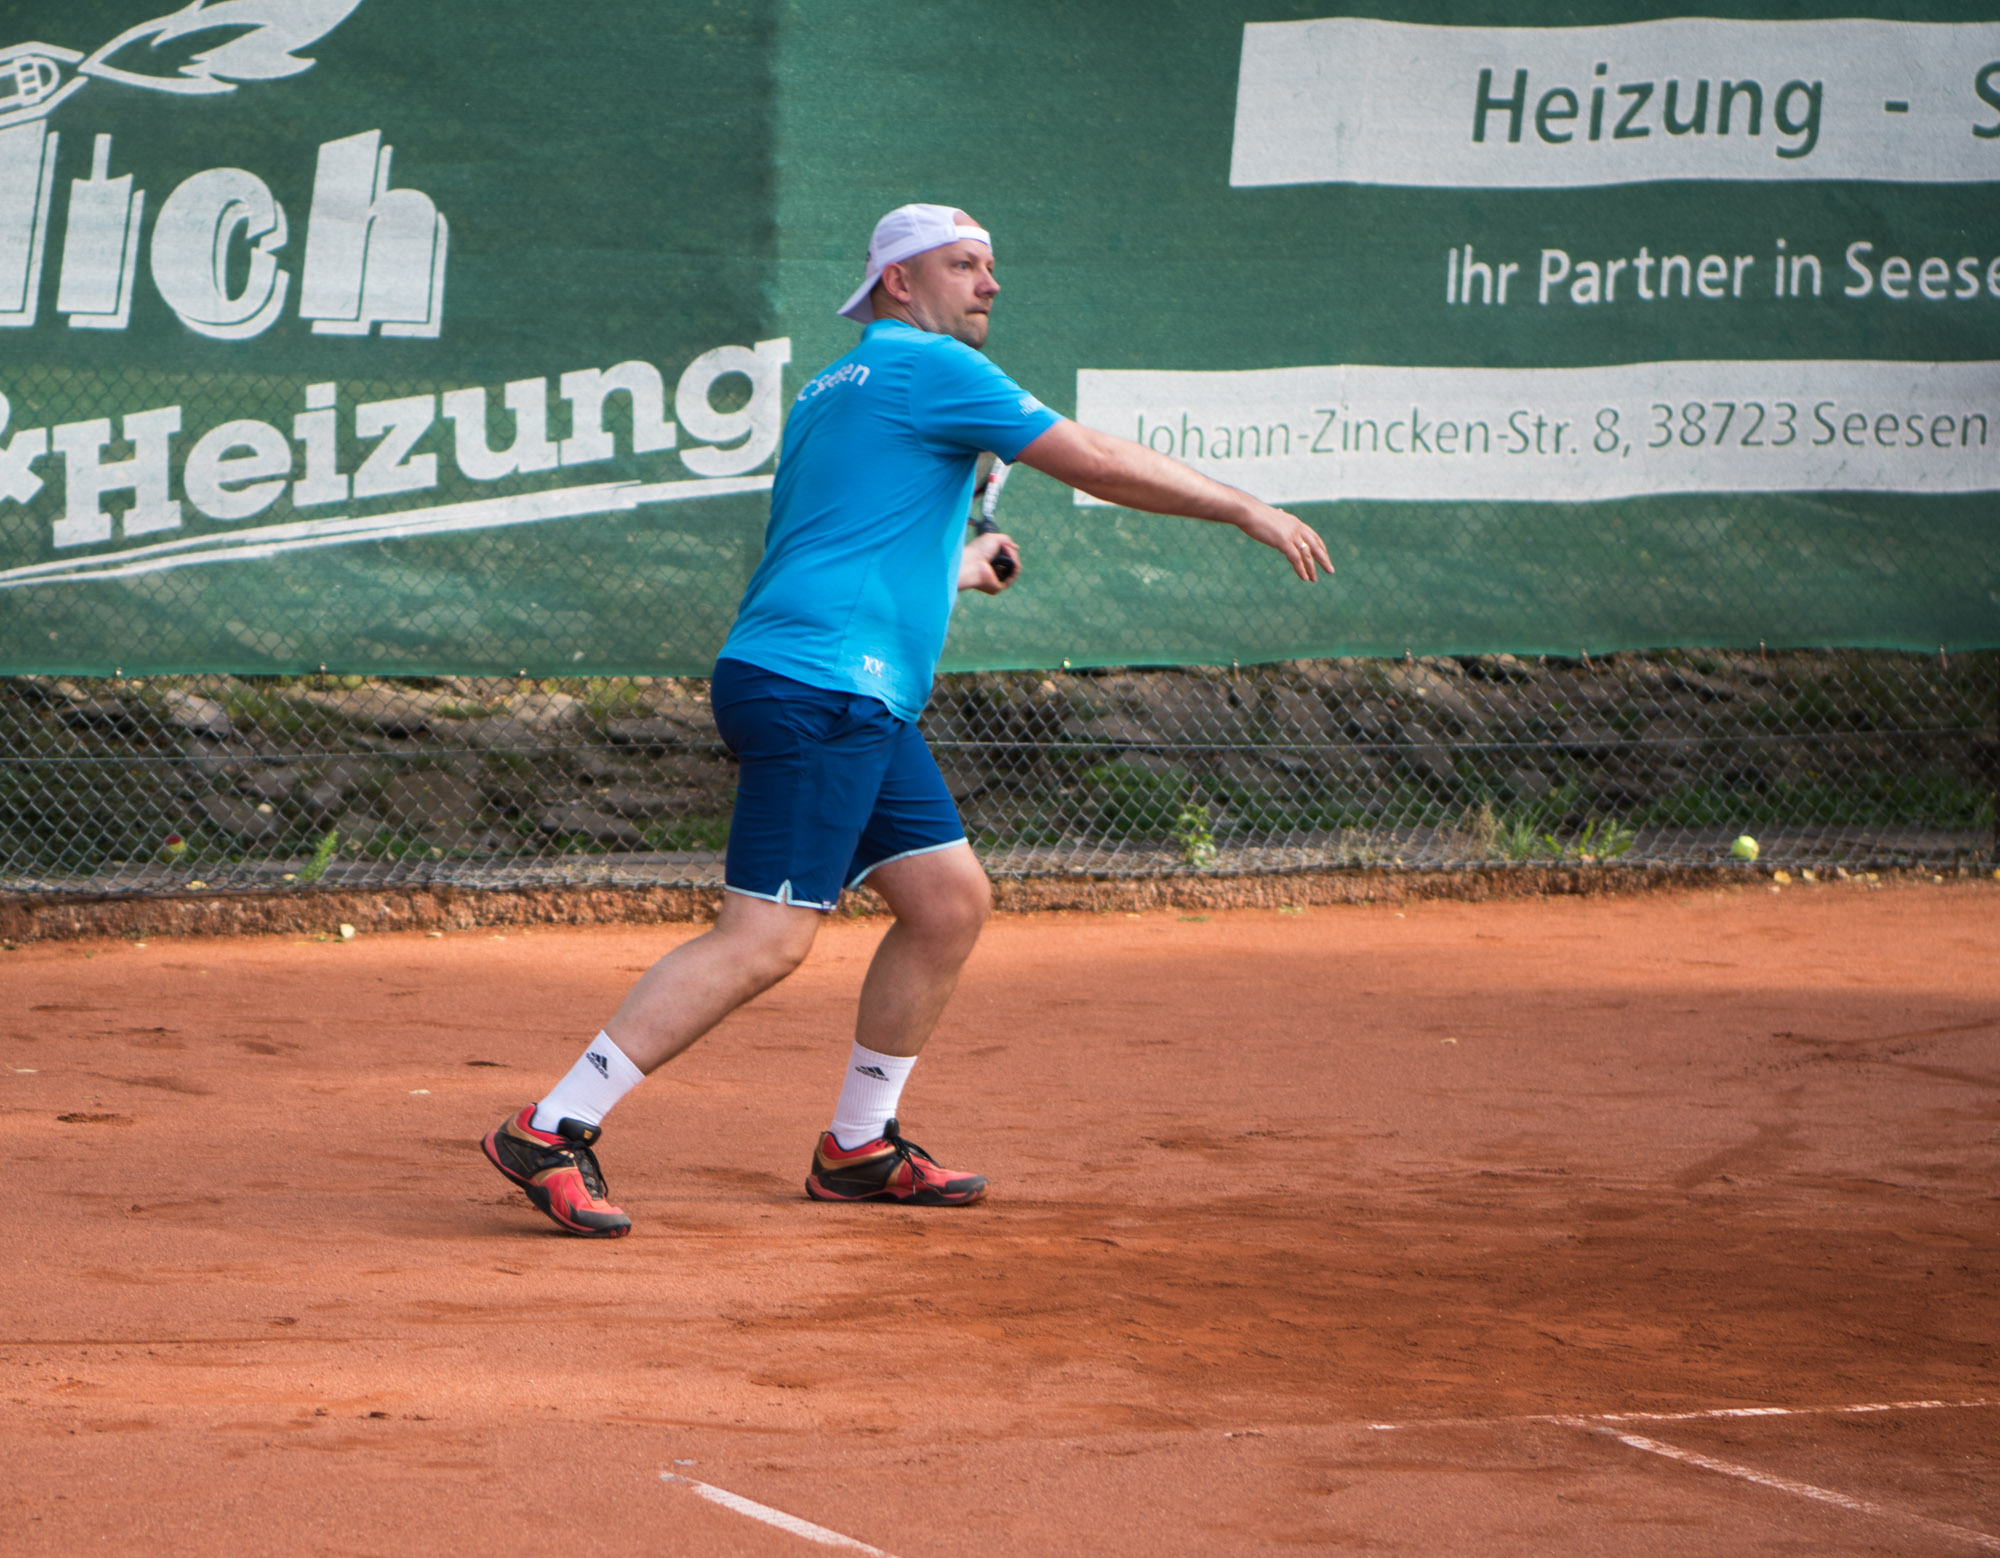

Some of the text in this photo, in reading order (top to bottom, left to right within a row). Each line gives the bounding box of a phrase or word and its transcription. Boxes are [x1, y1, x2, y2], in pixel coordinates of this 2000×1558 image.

[1472, 63, 1824, 159] Heizung
[1447, 244, 1518, 304] Ihr
[1538, 246, 1754, 304] Partner
[1775, 238, 1822, 296] in
[1593, 408, 1631, 458] 8,
[1648, 402, 1797, 448] 38723
[1812, 401, 1987, 448] Seesen
